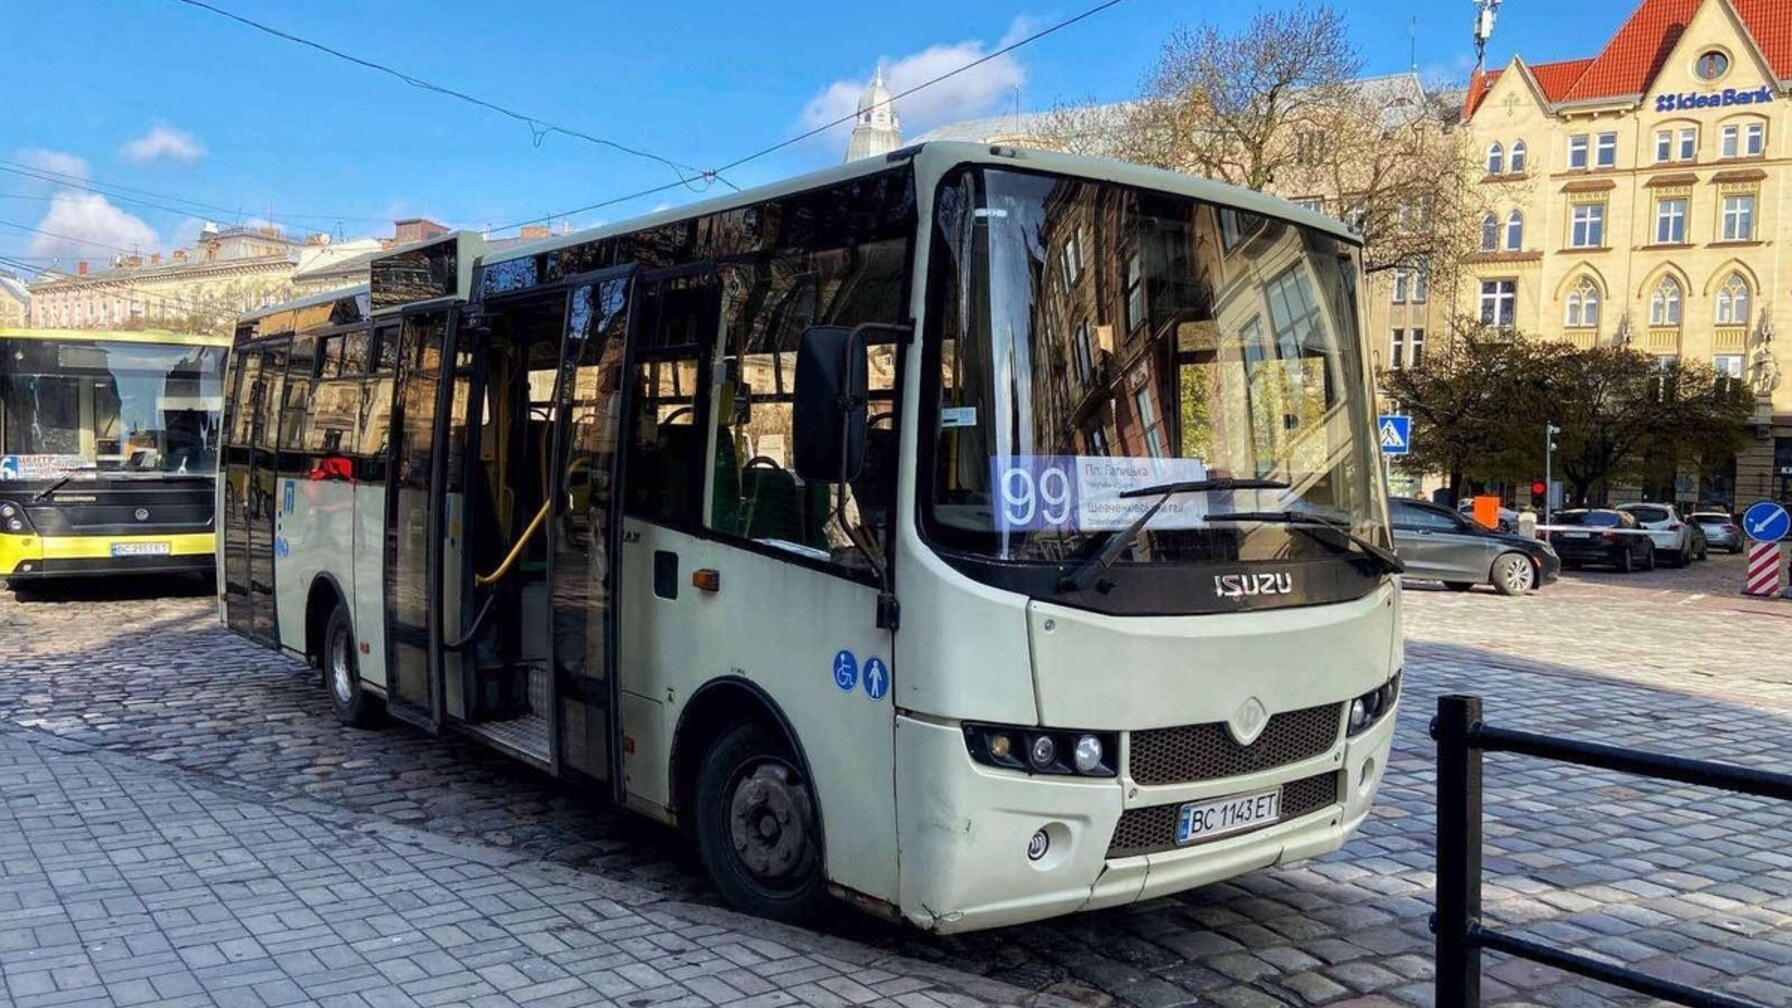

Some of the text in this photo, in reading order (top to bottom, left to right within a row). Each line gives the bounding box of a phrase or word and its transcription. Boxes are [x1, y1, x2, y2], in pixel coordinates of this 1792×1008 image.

[1001, 467, 1071, 526] 99
[1213, 572, 1293, 598] ISUZU
[1191, 793, 1276, 834] BC 1143 ET
